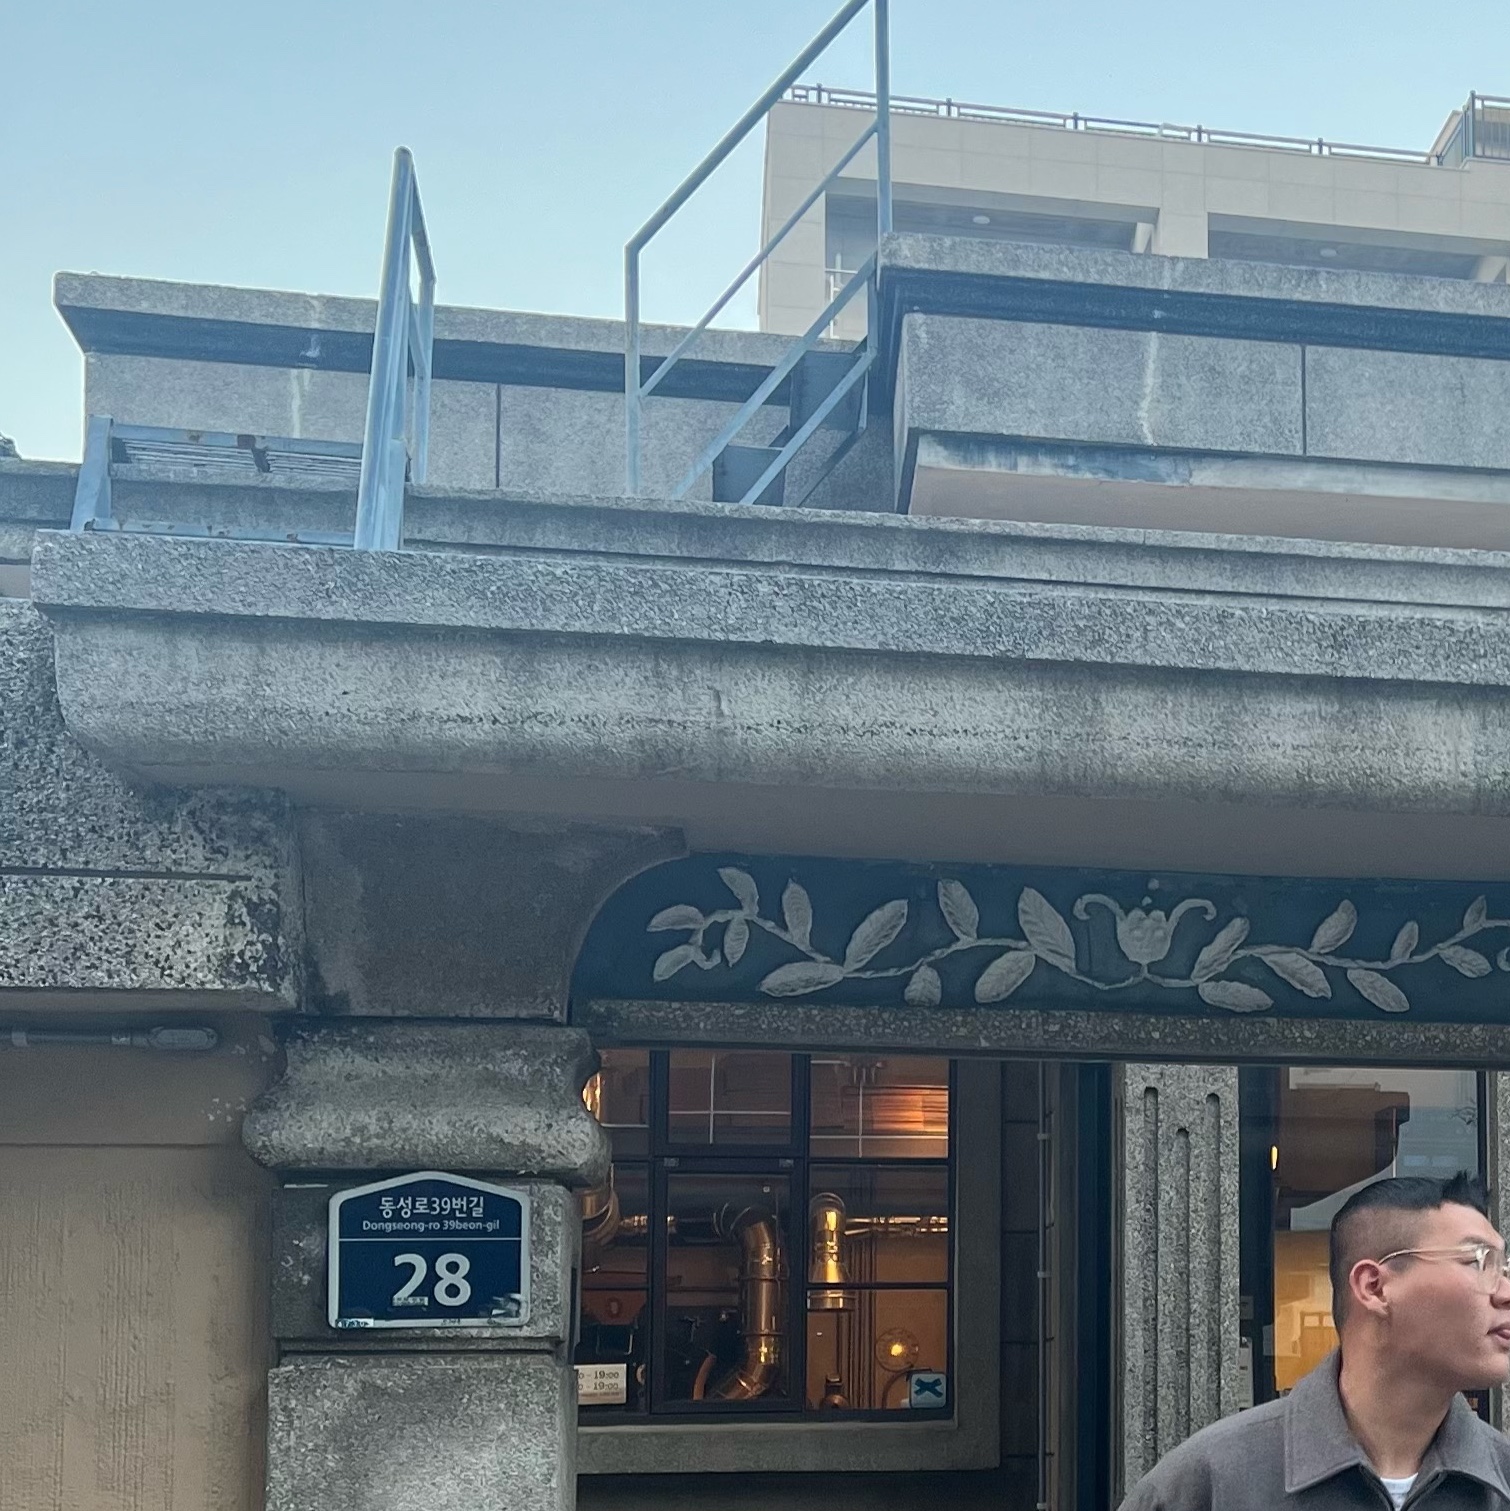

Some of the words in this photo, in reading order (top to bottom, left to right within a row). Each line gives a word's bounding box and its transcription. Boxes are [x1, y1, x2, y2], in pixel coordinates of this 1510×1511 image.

[379, 1196, 485, 1219] 동성로39번길
[362, 1220, 441, 1233] Dongseong-ro
[442, 1219, 500, 1233] 39beon-gil
[392, 1252, 472, 1307] 28
